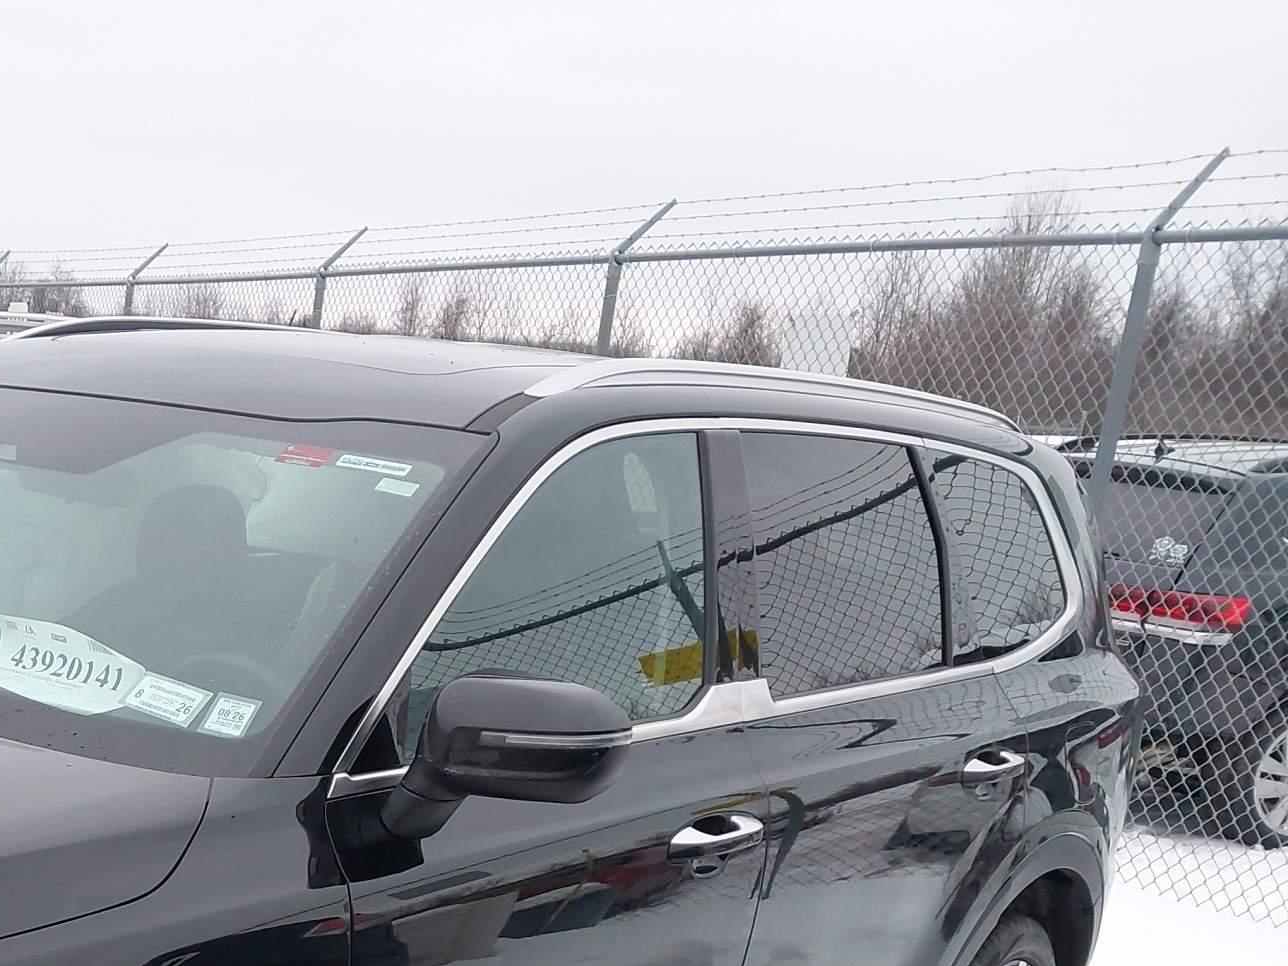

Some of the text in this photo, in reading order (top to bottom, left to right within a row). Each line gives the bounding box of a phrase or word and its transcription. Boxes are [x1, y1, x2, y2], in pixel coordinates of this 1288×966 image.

[11, 643, 124, 692] 43920141
[134, 688, 145, 699] 8
[175, 702, 193, 715] 26
[232, 711, 246, 721] 26
